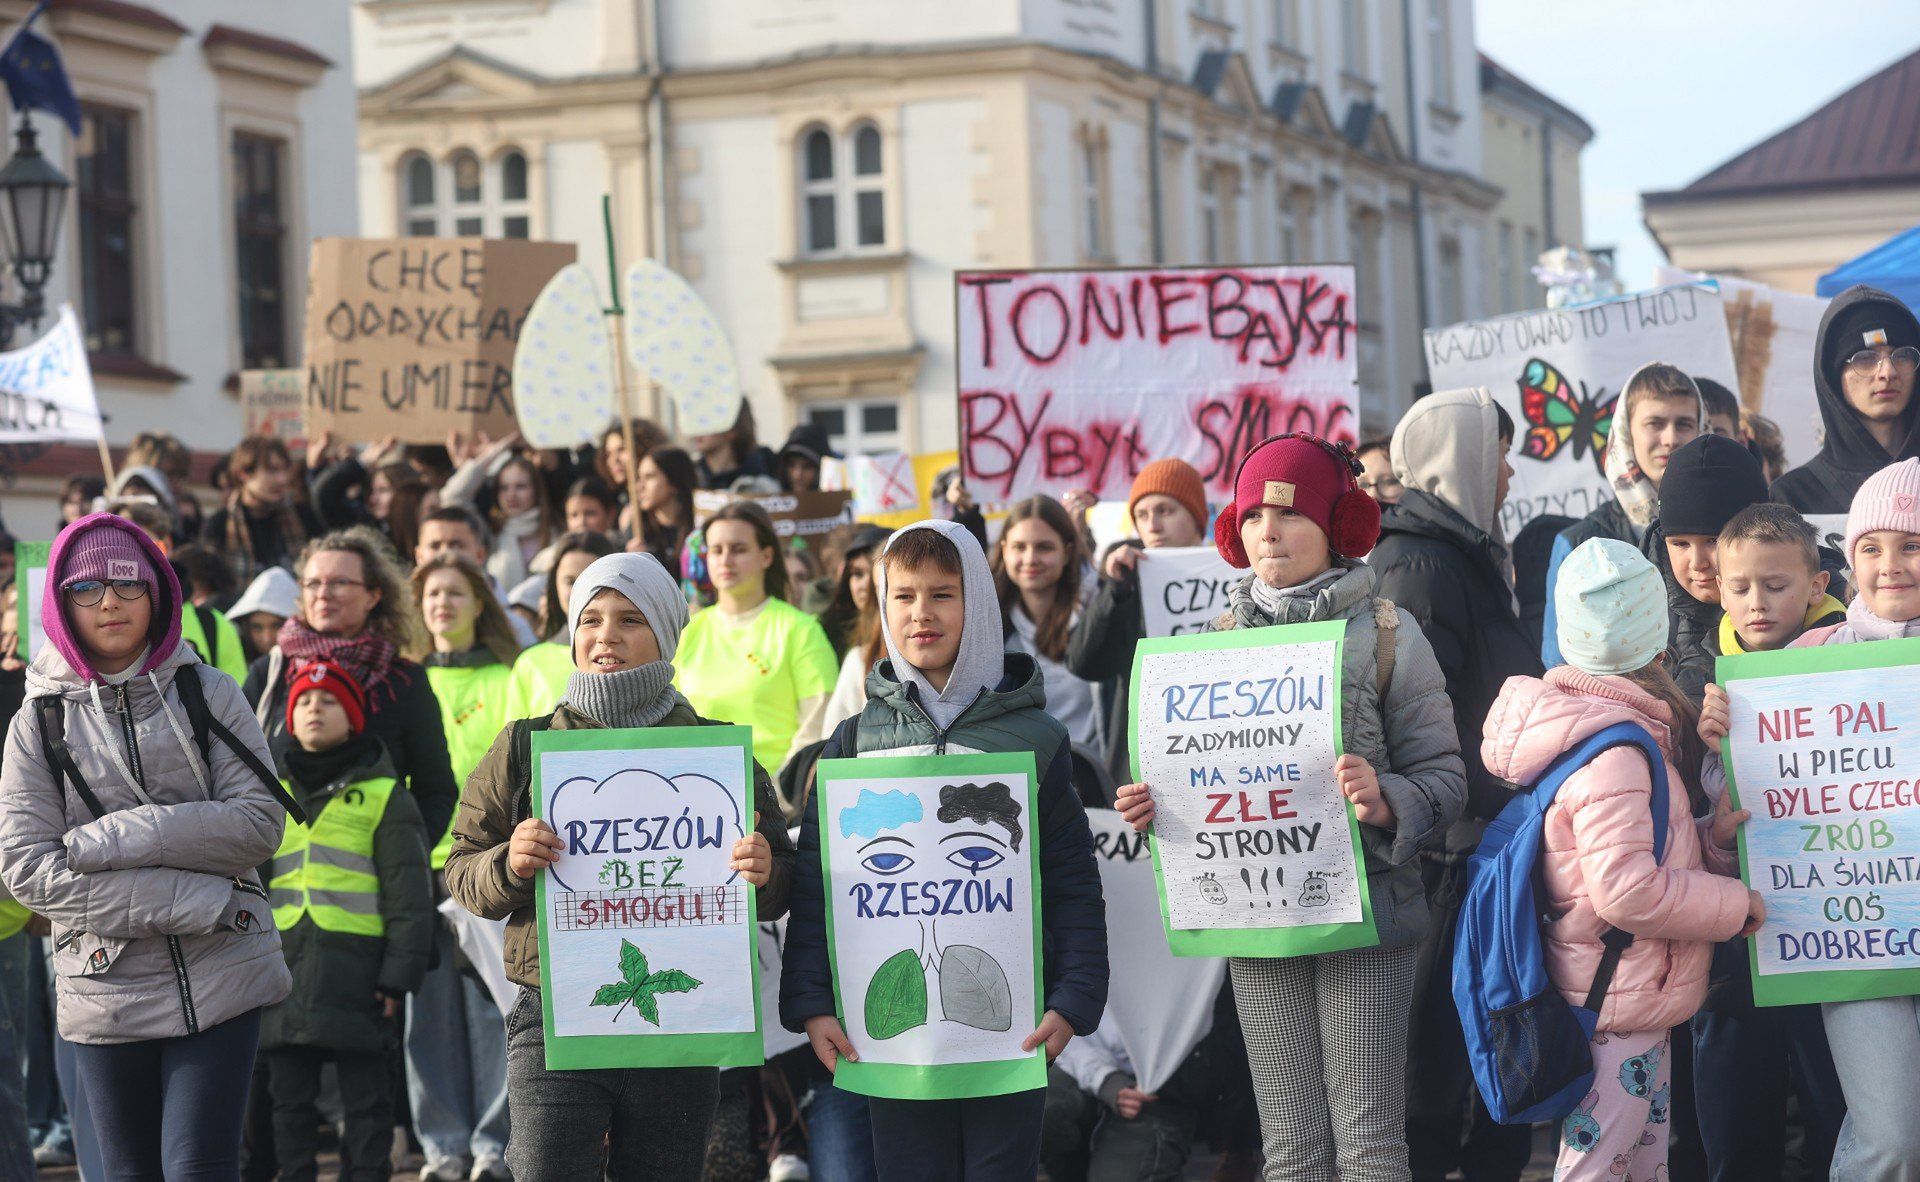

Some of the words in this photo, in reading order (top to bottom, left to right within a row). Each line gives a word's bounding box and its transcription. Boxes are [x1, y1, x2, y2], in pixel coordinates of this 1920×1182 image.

[367, 248, 486, 298] CHCĘ
[1514, 309, 1574, 350] OWAD
[308, 358, 362, 414] NIE
[111, 562, 134, 577] love
[1164, 577, 1242, 615] CZYS
[1162, 666, 1324, 723] RZESZÓW
[1166, 724, 1303, 754] ZADYMIONY
[1758, 707, 1815, 743] NIE
[1828, 701, 1898, 737] PAL
[1190, 766, 1226, 787] MA
[1238, 764, 1300, 784] SAME
[1778, 752, 1799, 779] W
[1810, 746, 1895, 776] PIECU
[1205, 788, 1298, 823] ZŁE
[1763, 785, 1841, 819] BYLE
[564, 806, 723, 855] RZESZÓW
[1195, 822, 1321, 860] STRONY
[1800, 817, 1895, 851] ZRÓB
[1770, 863, 1825, 890] DLA
[1833, 856, 1920, 886] ŚWIAT
[1823, 891, 1885, 922] COŚ
[1777, 928, 1920, 961] DOBREGO
